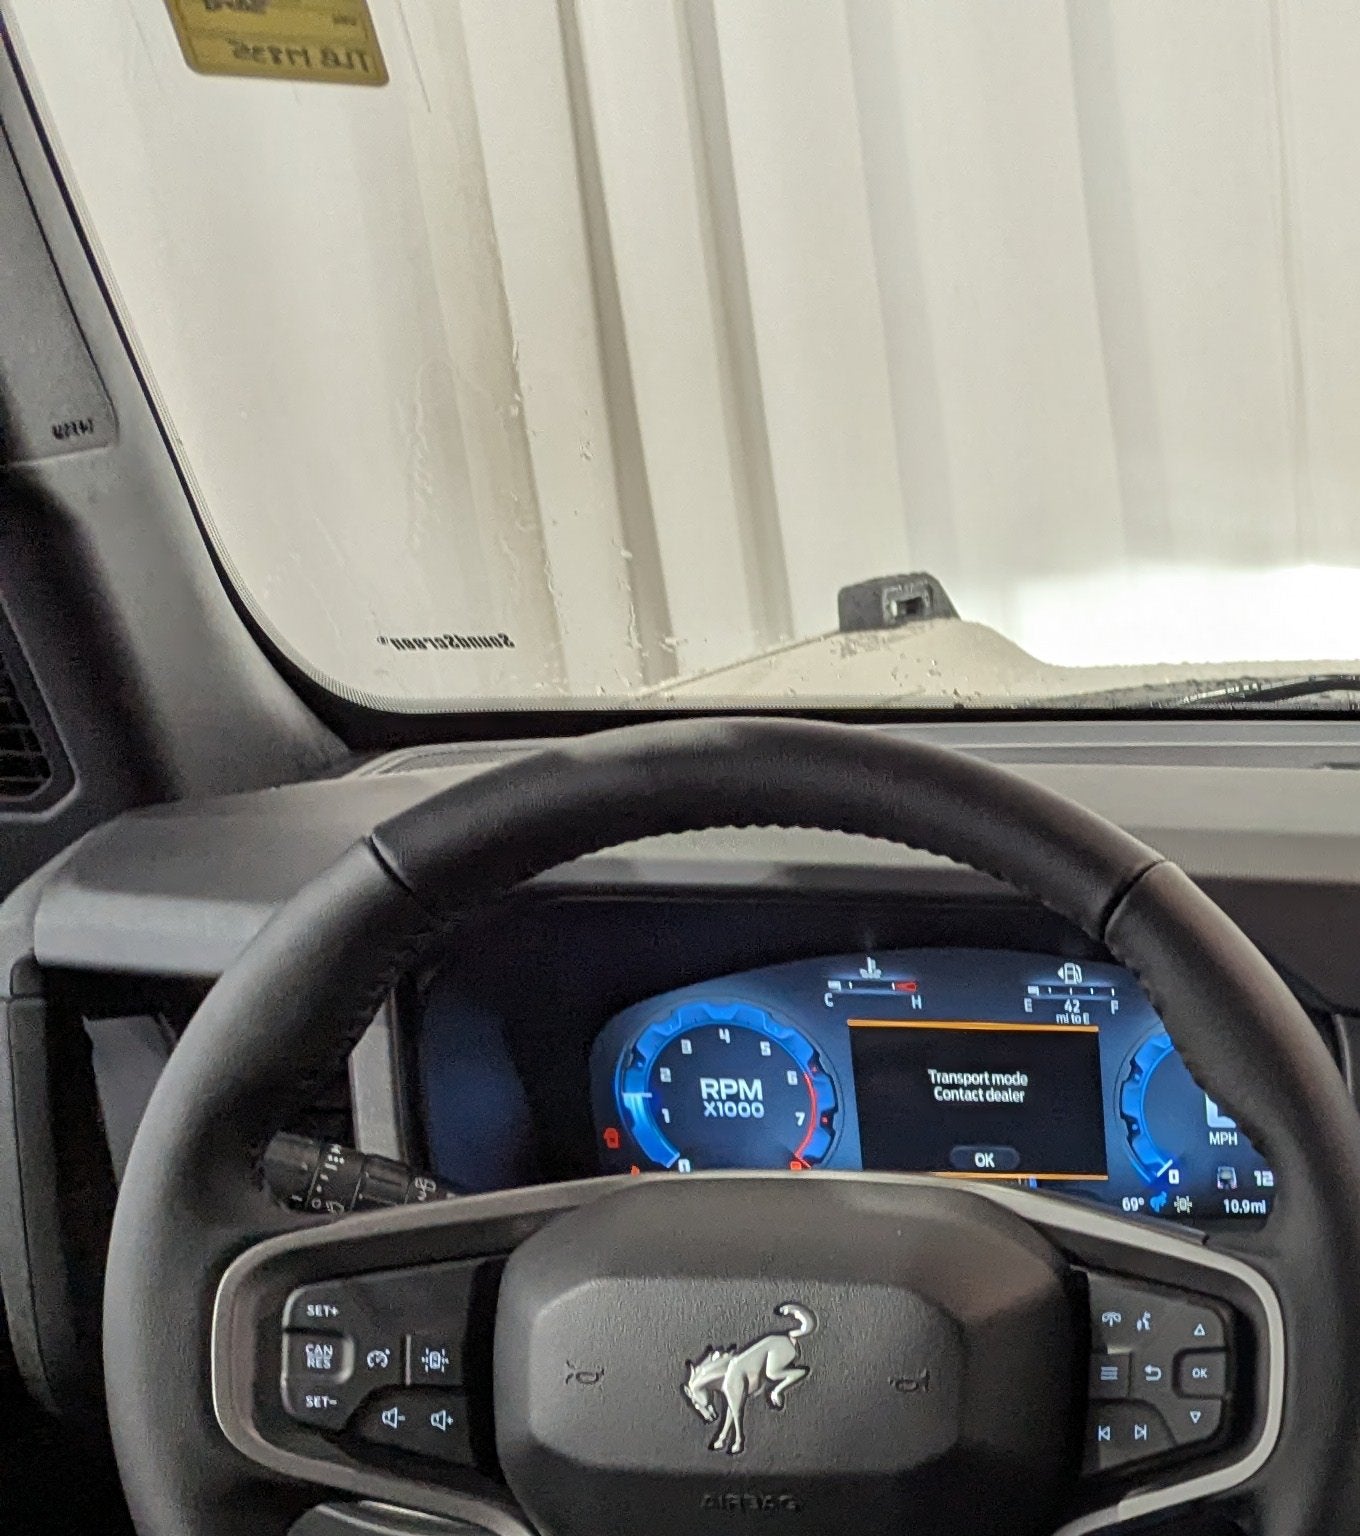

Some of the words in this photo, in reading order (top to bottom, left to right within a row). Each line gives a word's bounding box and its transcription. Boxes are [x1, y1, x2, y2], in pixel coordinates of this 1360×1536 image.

[1064, 999, 1080, 1013] 42
[1071, 1013, 1081, 1025] to
[719, 1028, 731, 1044] 4
[787, 1070, 798, 1085] 6
[928, 1069, 989, 1087] Transport
[991, 1071, 1028, 1086] mode
[700, 1078, 762, 1101] RPM
[934, 1087, 984, 1102] Contact
[986, 1088, 1026, 1103] dealer
[703, 1101, 765, 1118] X1000
[795, 1111, 806, 1126] 7
[1209, 1131, 1238, 1146] MPH
[974, 1153, 996, 1168] OK
[305, 1344, 333, 1356] CAN
[1192, 1367, 1208, 1379] OK
